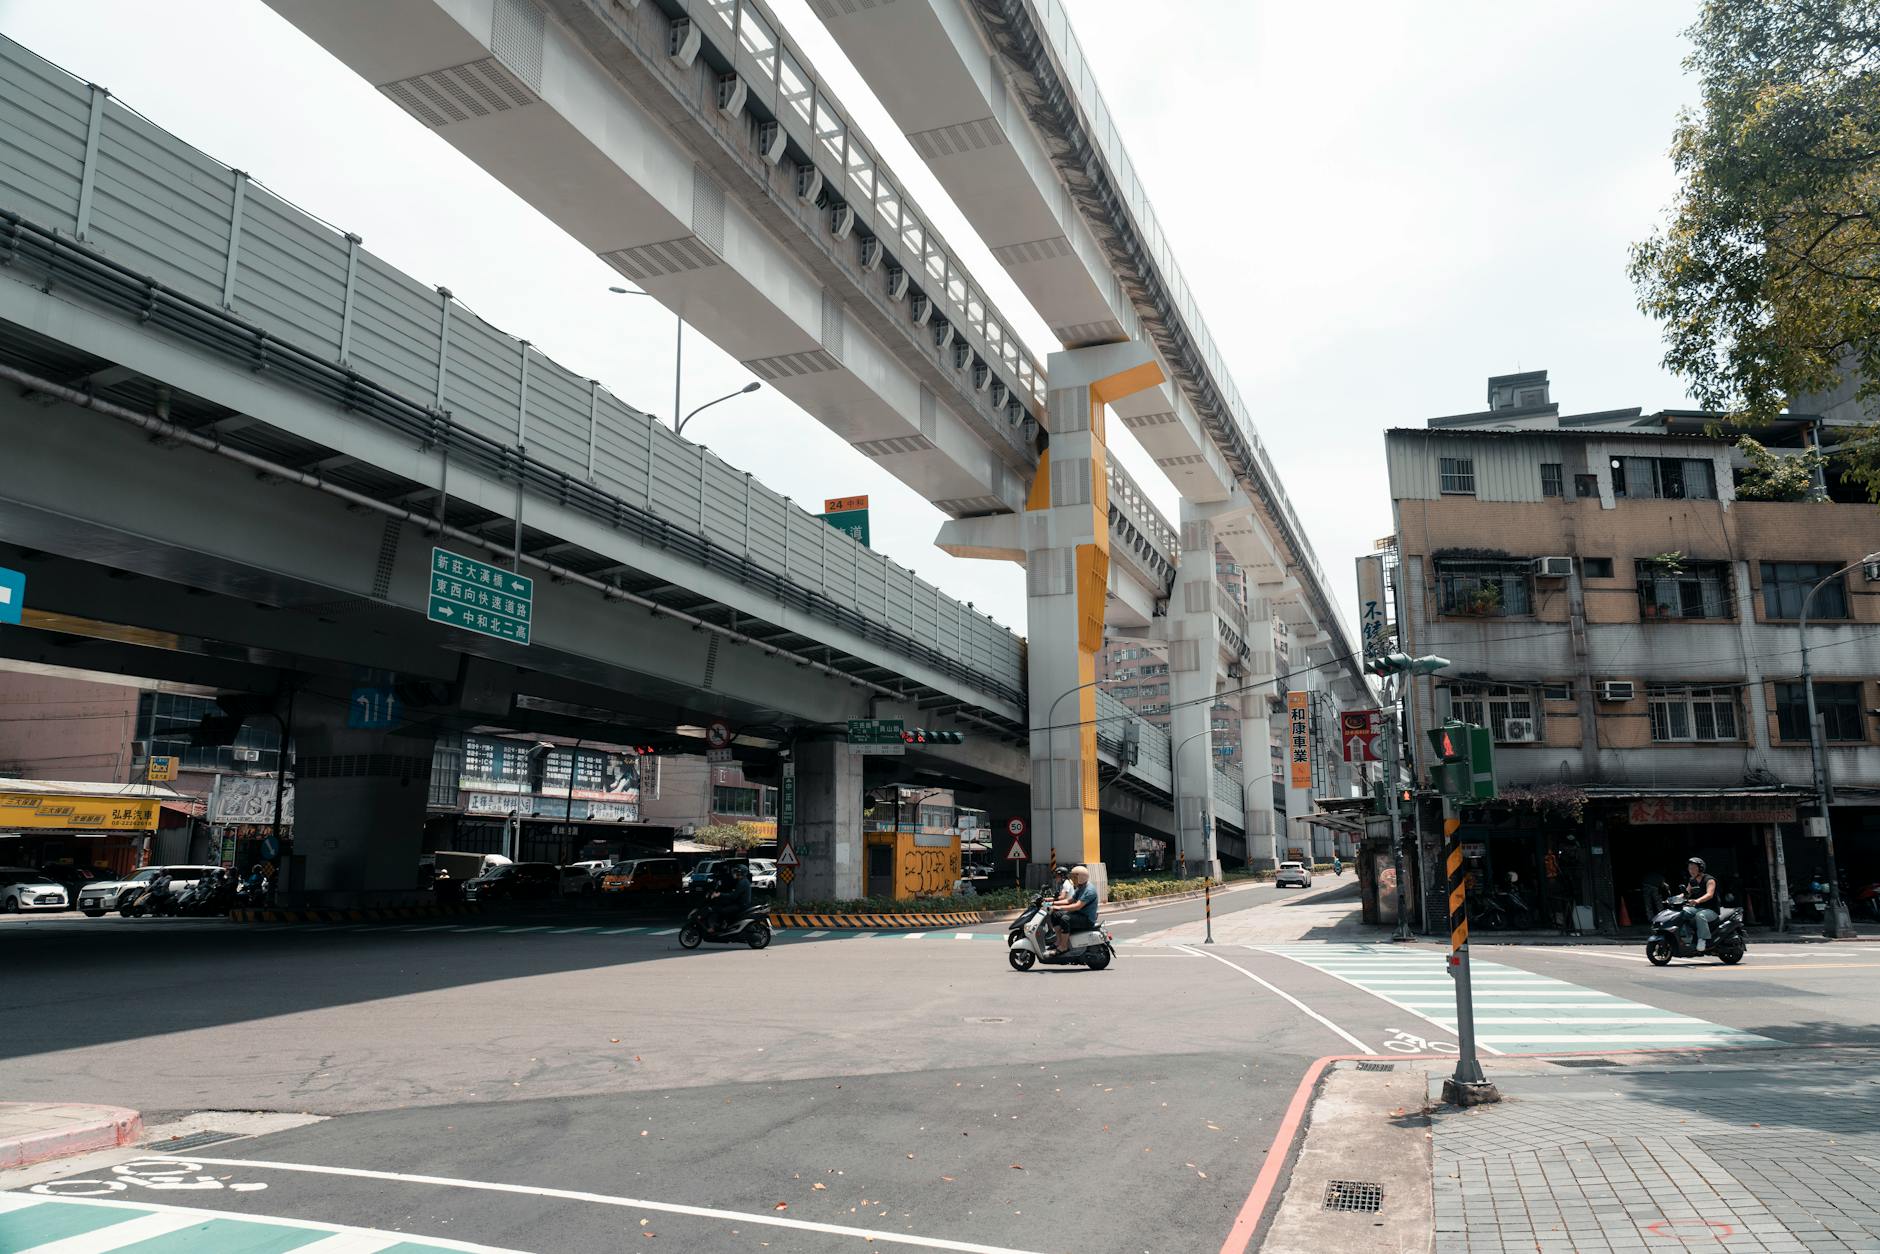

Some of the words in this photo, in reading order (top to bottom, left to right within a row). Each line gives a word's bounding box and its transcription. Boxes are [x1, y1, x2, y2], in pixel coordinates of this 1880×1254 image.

[830, 500, 843, 510] 24
[437, 554, 503, 588] 新莊大漢橋
[436, 578, 527, 617] 東西向快速道路
[463, 609, 527, 639] 中和北二高
[1291, 708, 1307, 763] 和康車業
[112, 809, 152, 820] 弘昇汽車
[1011, 823, 1022, 831] 50
